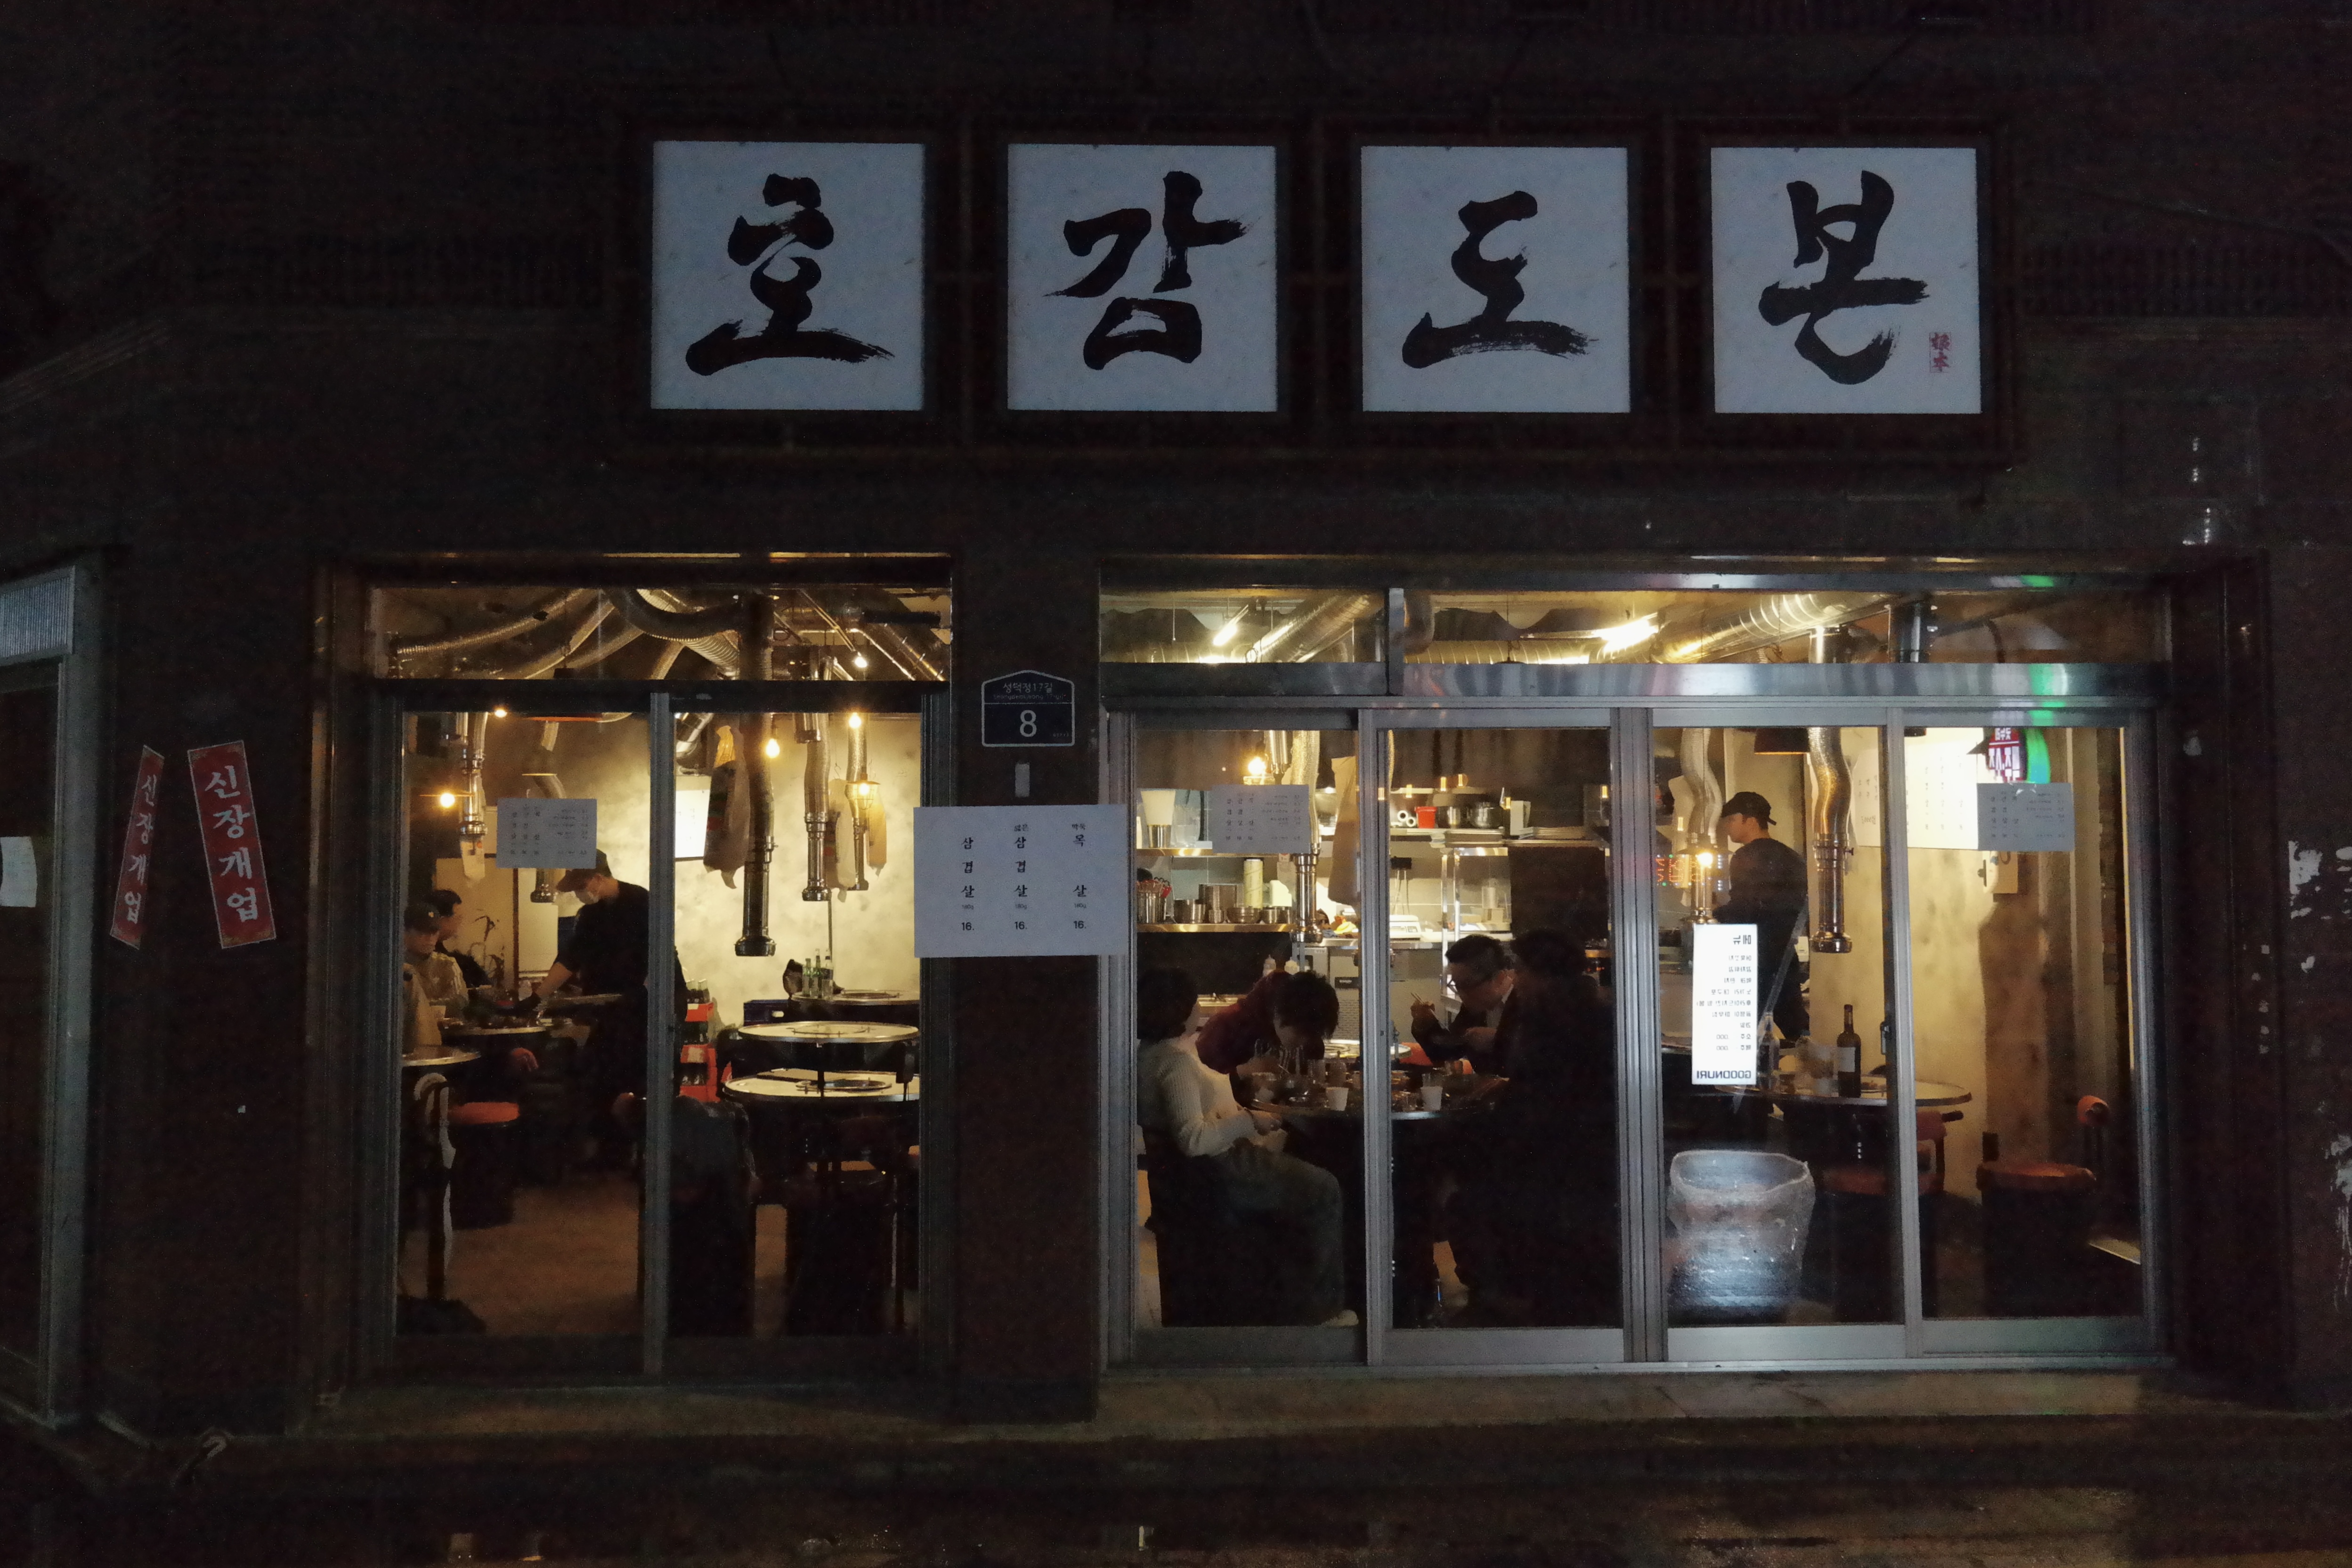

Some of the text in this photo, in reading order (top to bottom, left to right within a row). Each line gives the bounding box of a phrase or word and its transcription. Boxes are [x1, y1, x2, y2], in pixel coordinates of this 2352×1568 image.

[1020, 710, 1037, 738] 8
[124, 775, 157, 924] 신장개업
[204, 765, 260, 923] 신장개업
